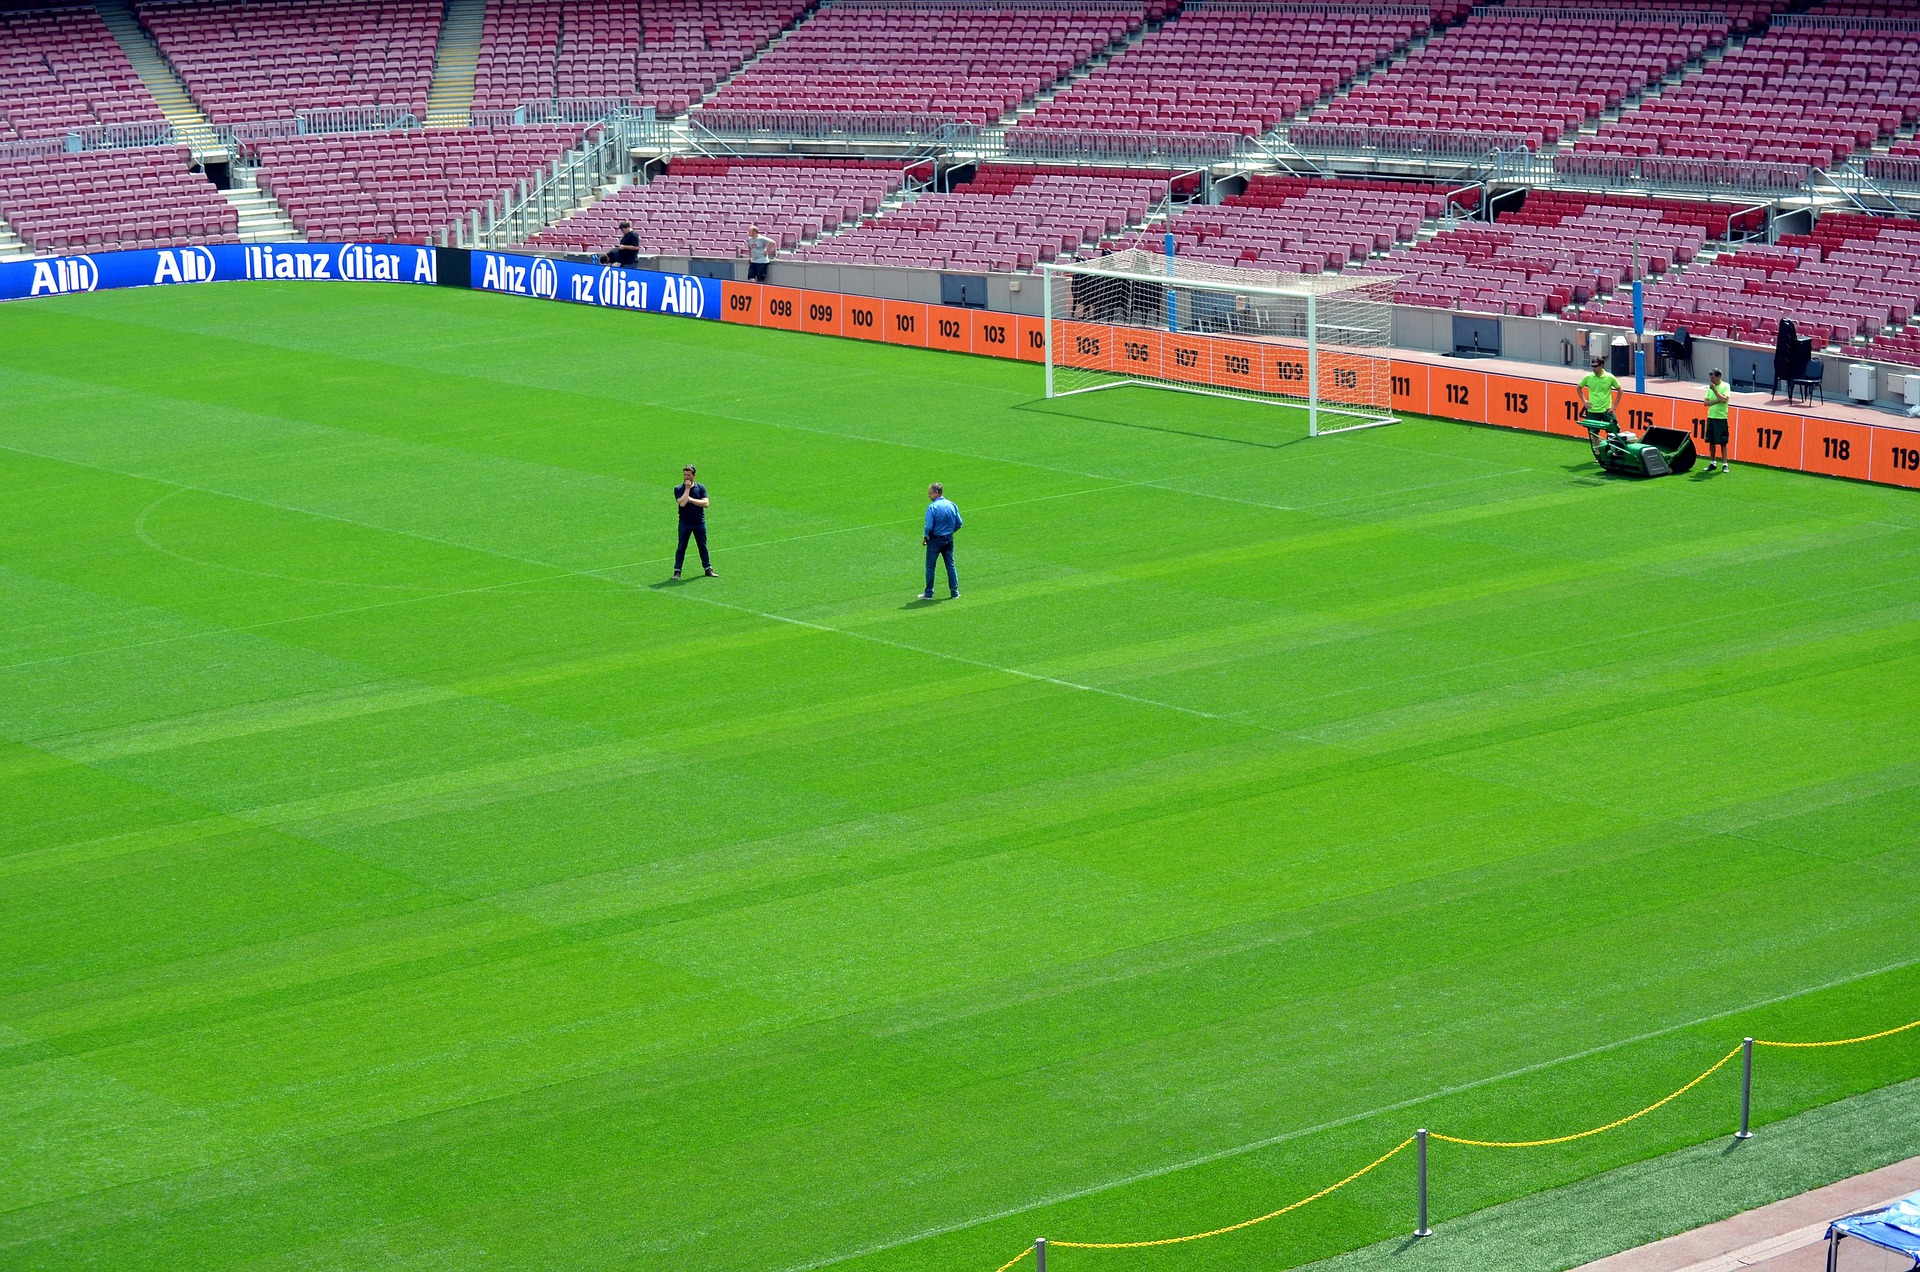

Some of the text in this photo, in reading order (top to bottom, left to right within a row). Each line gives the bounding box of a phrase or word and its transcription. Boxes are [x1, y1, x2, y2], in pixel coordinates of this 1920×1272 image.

[730, 294, 752, 312] 097
[770, 299, 792, 317] 098
[810, 304, 833, 322] 099
[852, 309, 873, 327] 100
[896, 314, 915, 332] 101
[939, 320, 960, 338] 102
[984, 325, 1005, 344] 103
[1029, 331, 1045, 348] 10
[1076, 336, 1100, 355] 105
[1125, 342, 1149, 362] 106
[1175, 348, 1199, 368] 107
[1225, 355, 1249, 375] 108
[1277, 361, 1304, 381] 109
[1333, 368, 1357, 389] 110
[1391, 376, 1410, 396] 111
[1446, 384, 1469, 405] 112
[1504, 392, 1528, 414] 113
[1628, 409, 1654, 431] 115
[1692, 418, 1706, 439] 11
[1757, 427, 1782, 450] 117
[1823, 437, 1850, 461] 118
[1892, 447, 1919, 470] 119
